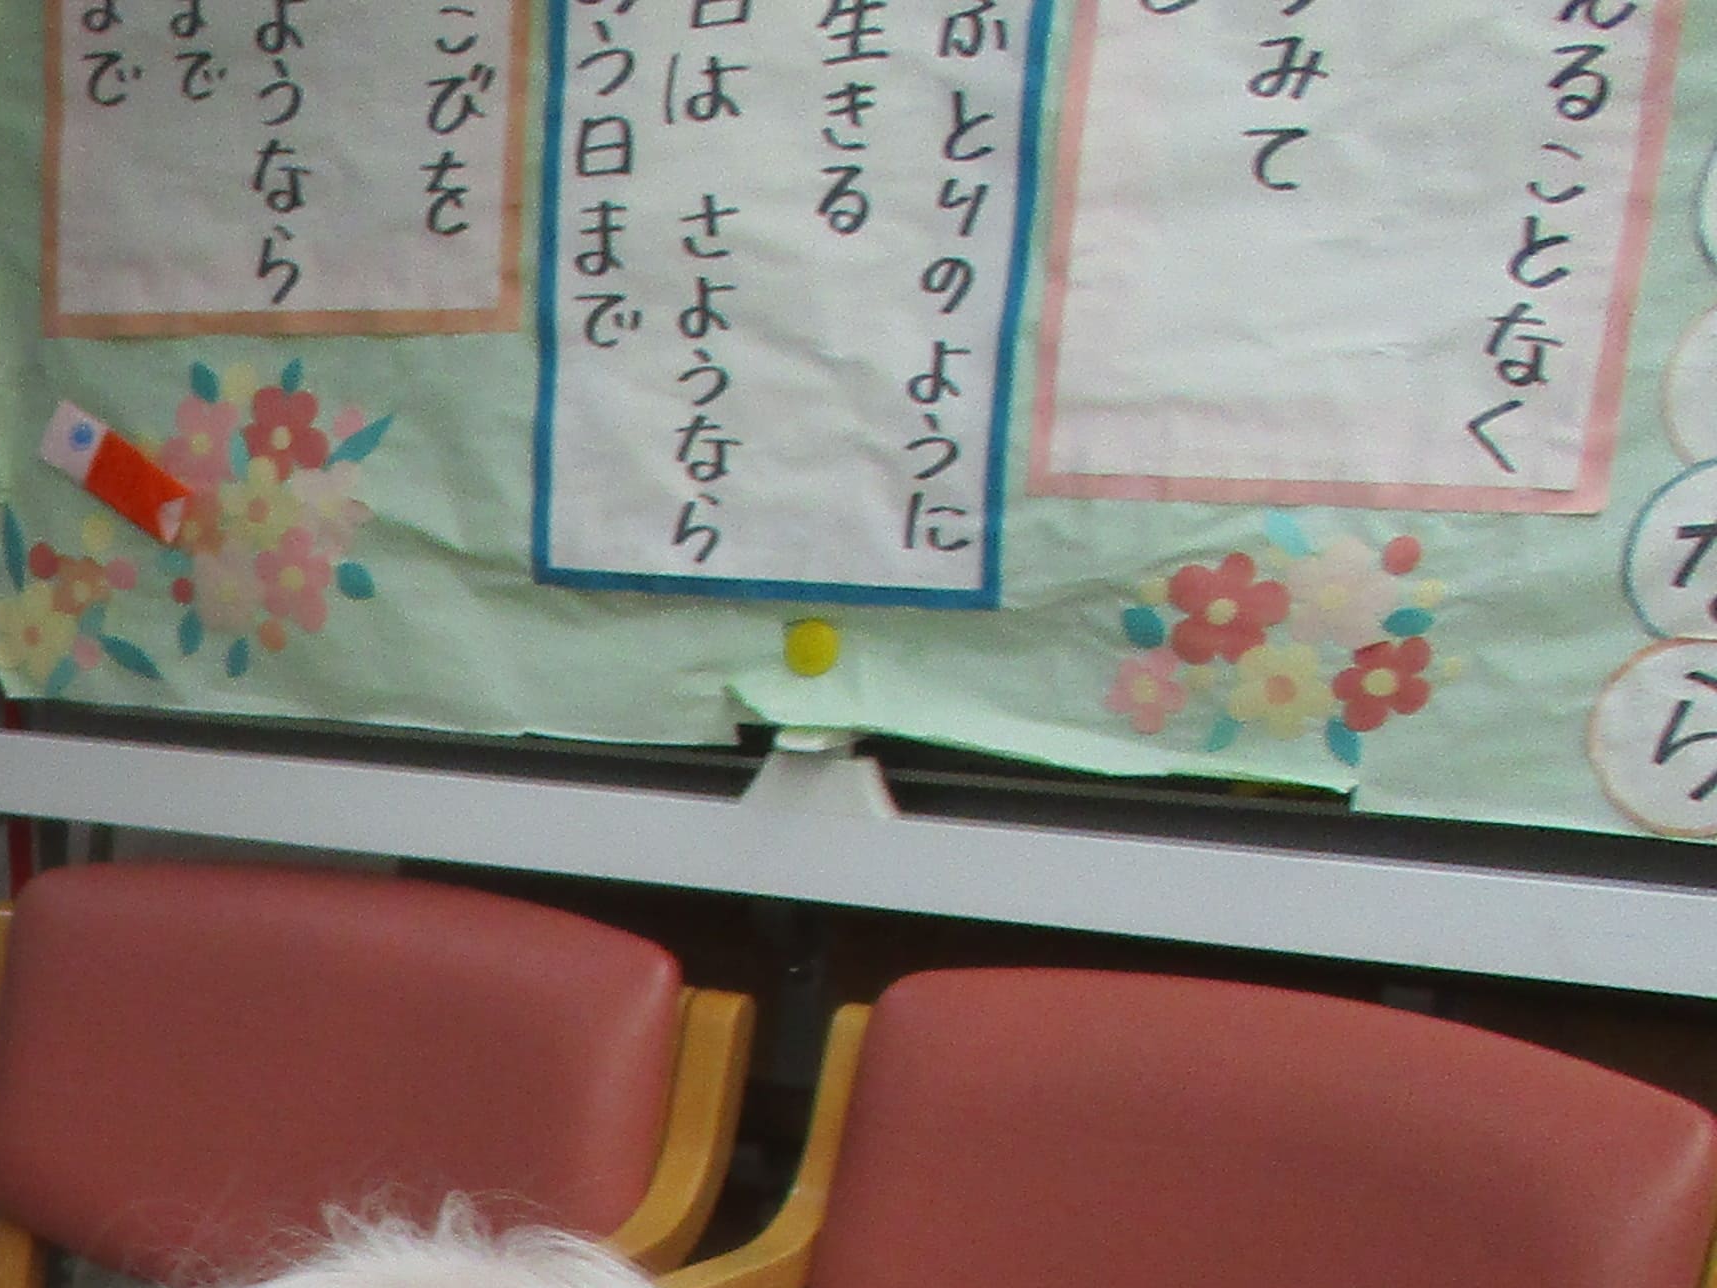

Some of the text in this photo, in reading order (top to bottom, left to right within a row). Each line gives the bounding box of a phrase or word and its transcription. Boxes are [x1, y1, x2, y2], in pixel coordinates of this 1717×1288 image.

[421, 5, 495, 235] こびを
[574, 0, 641, 348] う日まで
[817, 0, 889, 235] 生きる
[1241, 0, 1328, 190] みて
[672, 195, 743, 563] さようなら
